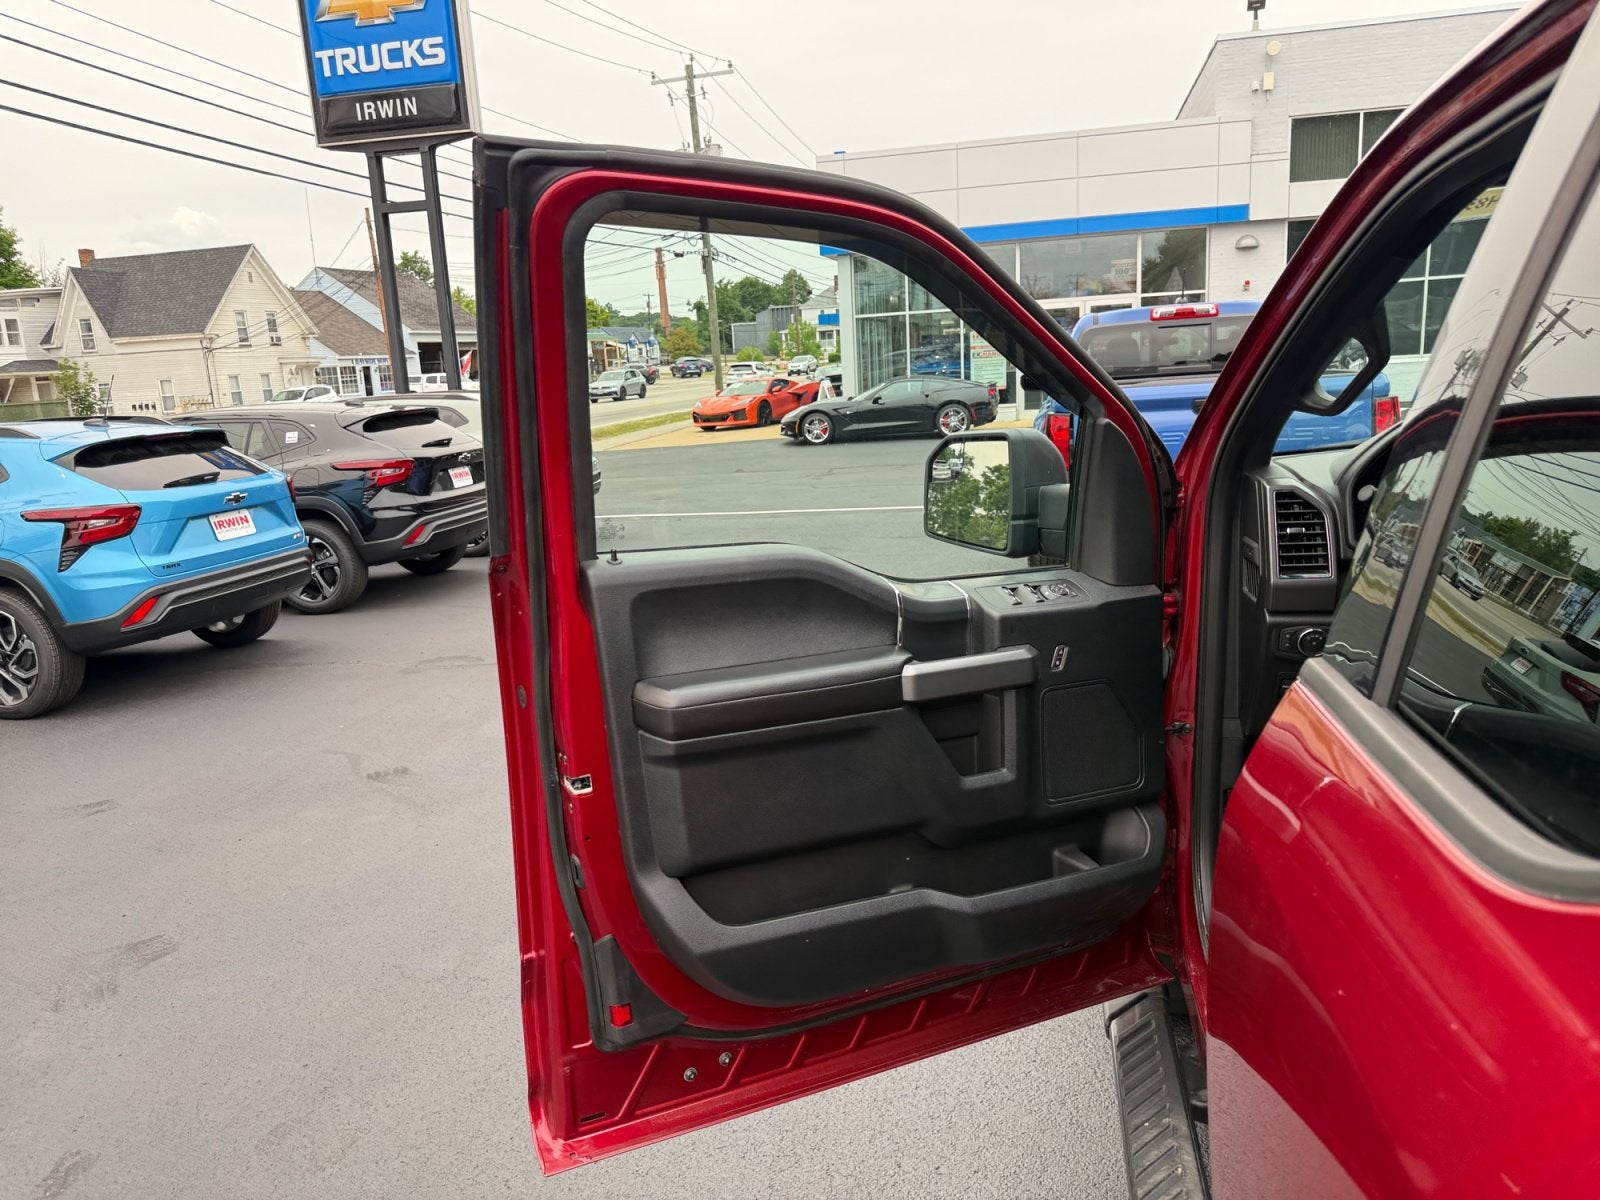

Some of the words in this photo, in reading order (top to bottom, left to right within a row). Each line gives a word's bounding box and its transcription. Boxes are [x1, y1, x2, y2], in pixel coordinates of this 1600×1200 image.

[315, 36, 446, 78] TRUCKS
[355, 96, 418, 121] IRWIN
[213, 514, 250, 531] IRWIN
